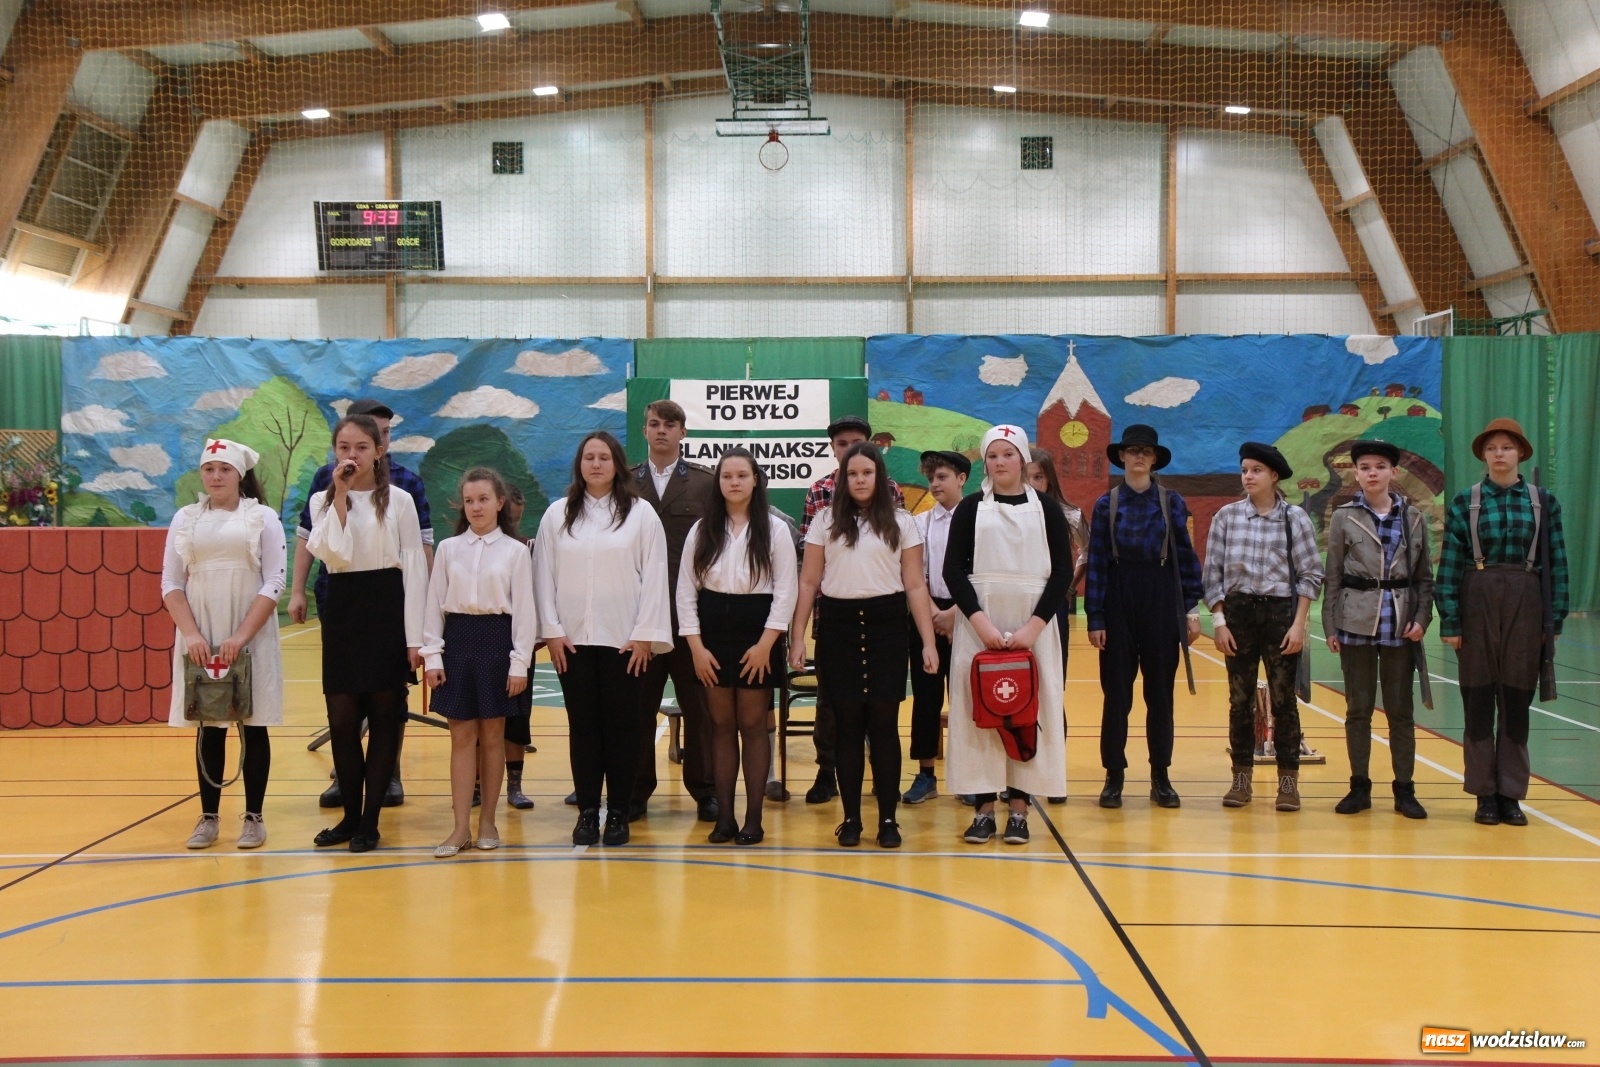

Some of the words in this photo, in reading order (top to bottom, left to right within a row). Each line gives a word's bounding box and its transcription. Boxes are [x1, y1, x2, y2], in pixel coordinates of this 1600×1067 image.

[362, 210, 398, 225] 9:33
[330, 237, 372, 246] GOSPODARZE
[397, 236, 420, 246] GOŚCIE
[706, 384, 799, 401] PIERWEJ
[707, 404, 736, 421] TO
[742, 403, 799, 420] BYŁO
[679, 442, 743, 458] LAN
[750, 442, 836, 458] INAKSZ
[758, 463, 812, 479] ZISIO
